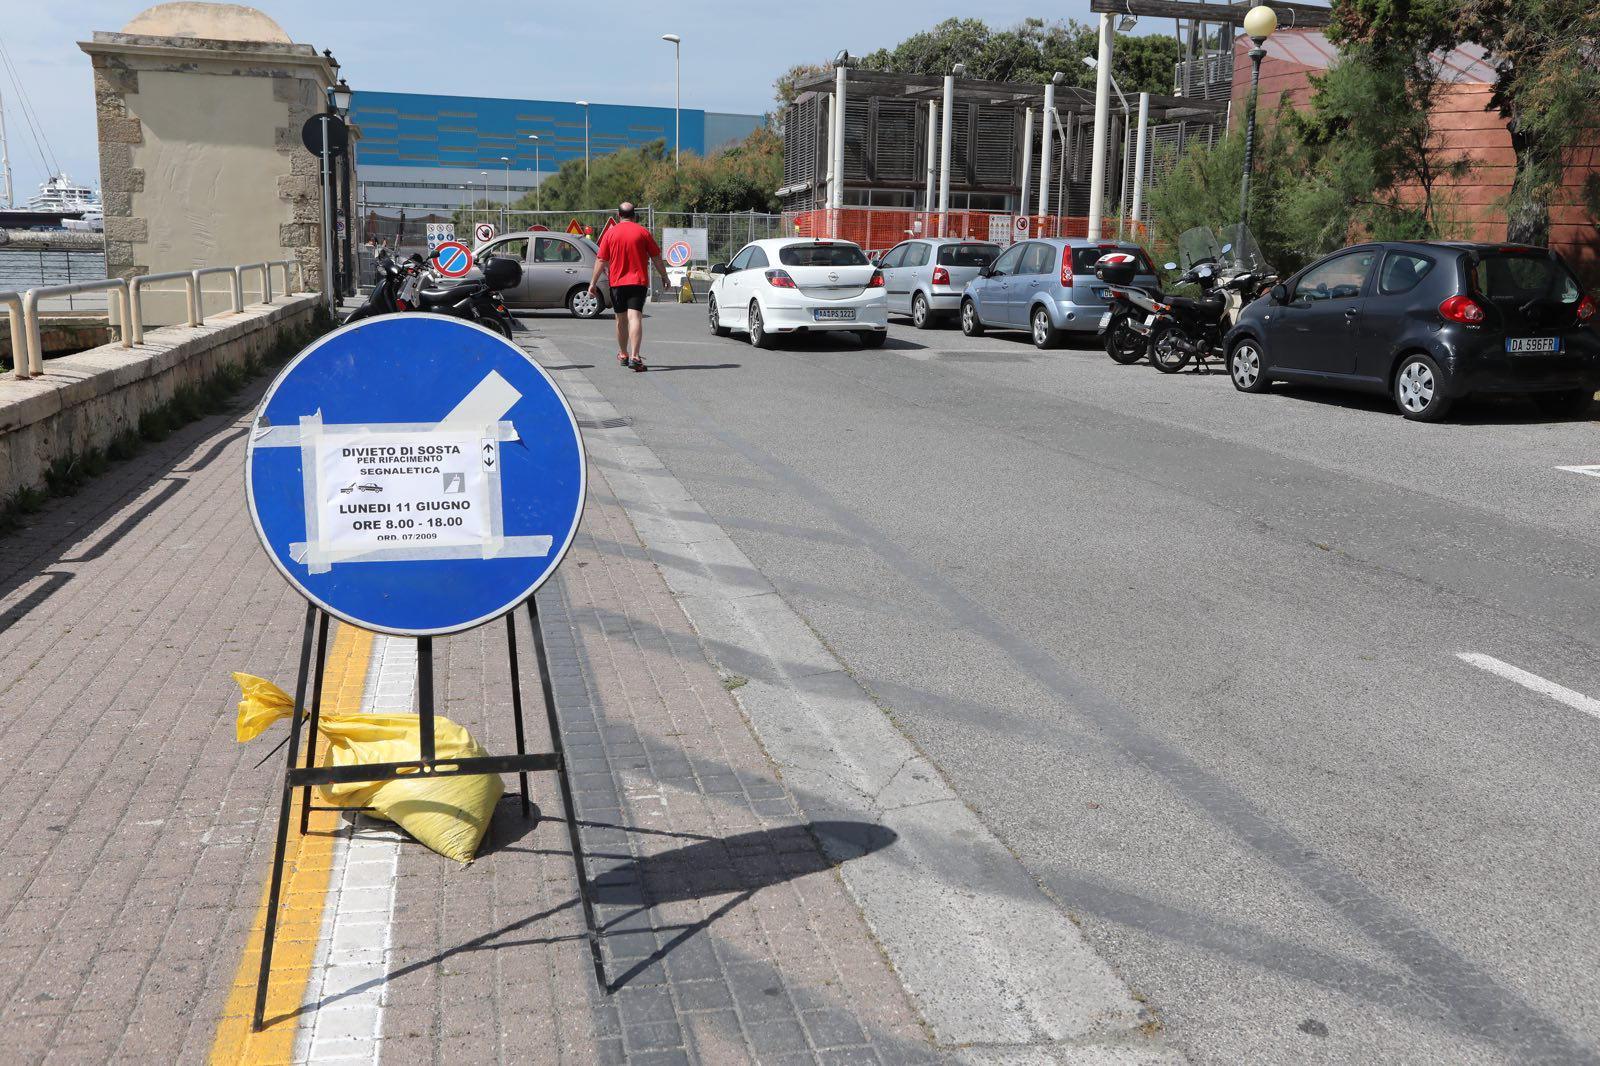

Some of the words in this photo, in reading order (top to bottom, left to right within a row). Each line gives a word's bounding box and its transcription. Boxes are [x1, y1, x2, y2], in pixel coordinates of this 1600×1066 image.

[1512, 339, 1523, 351] DA
[1526, 338, 1554, 351] 596FR
[342, 447, 396, 457] DIVIETO
[400, 446, 413, 456] DI
[418, 445, 461, 455] SOSTA
[357, 456, 376, 464] PER
[378, 455, 443, 463] RIFACIMENTO
[360, 466, 440, 475] SEGNALETICA
[339, 503, 391, 514] LUNEDI
[395, 502, 411, 512] 11
[416, 500, 471, 512] GIUGNO
[352, 520, 382, 530] ORE
[385, 519, 415, 529] 8.00
[426, 516, 463, 528] 18.00
[377, 534, 400, 542] ORD.
[401, 532, 438, 541] 07/2009
